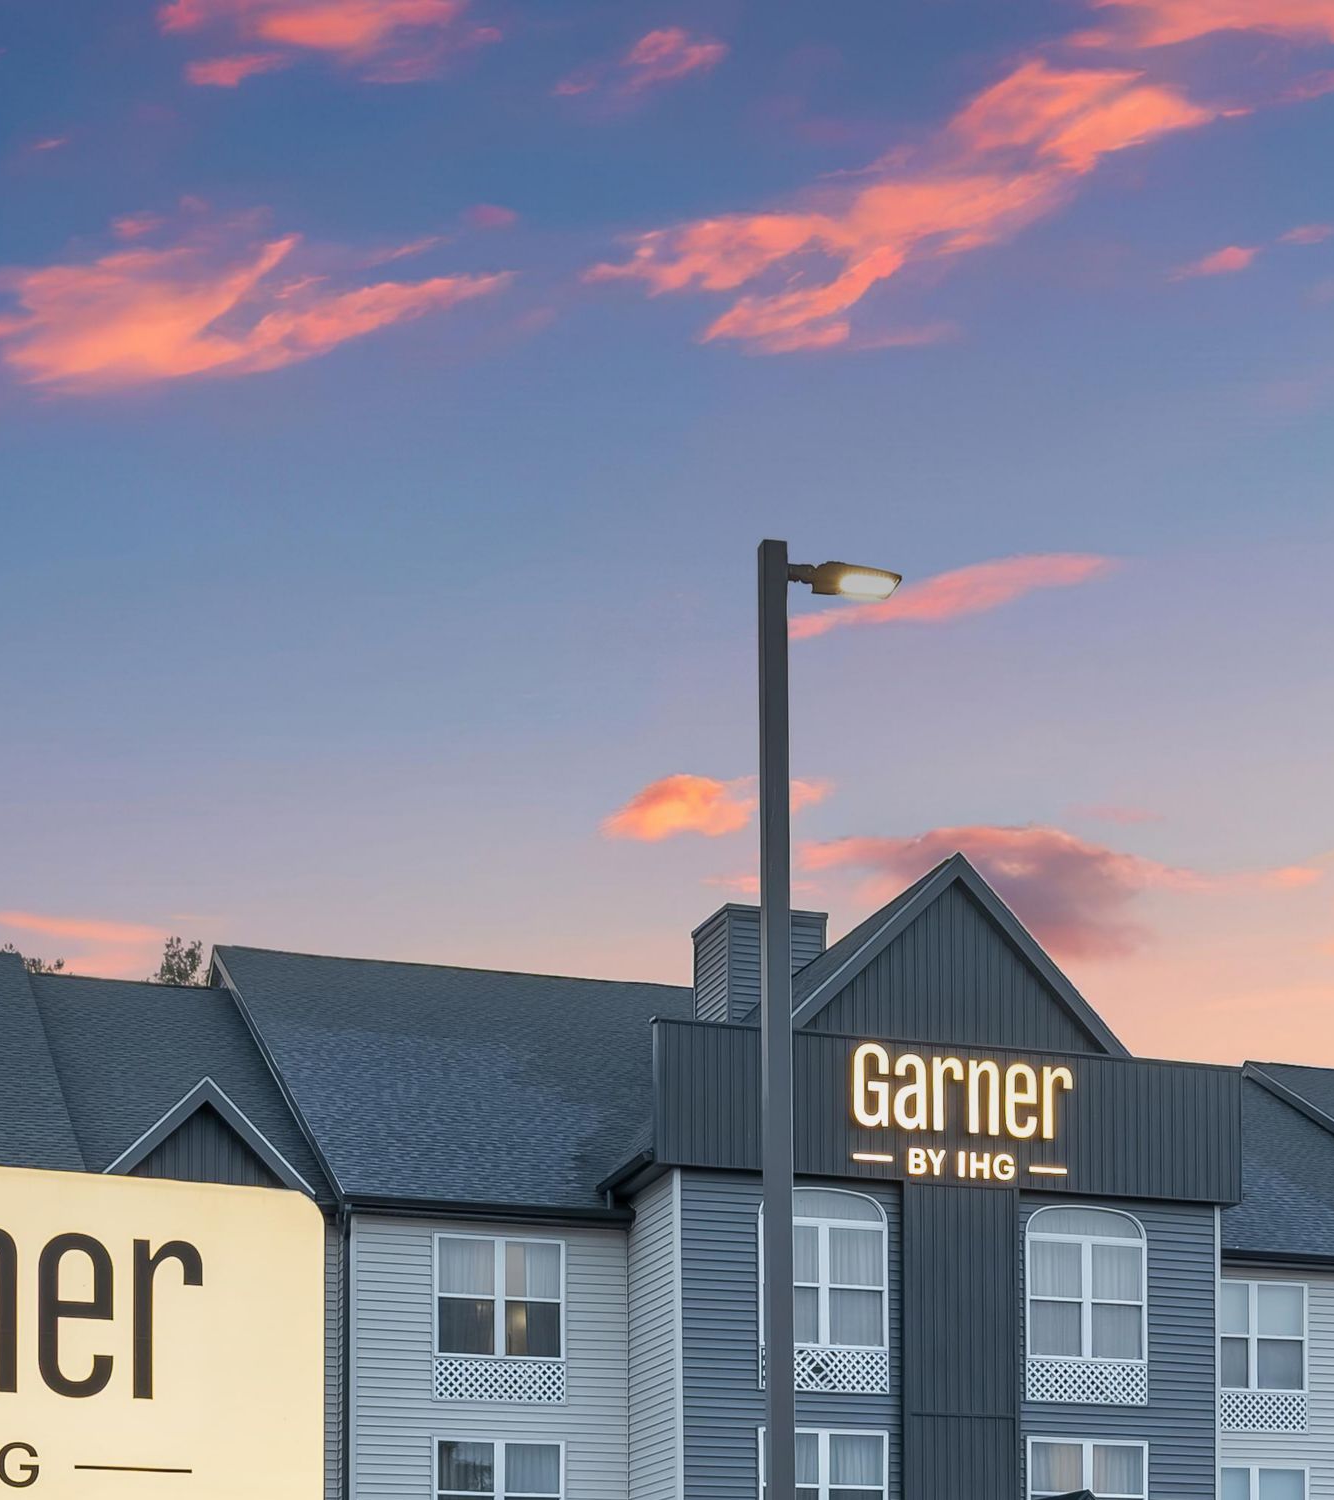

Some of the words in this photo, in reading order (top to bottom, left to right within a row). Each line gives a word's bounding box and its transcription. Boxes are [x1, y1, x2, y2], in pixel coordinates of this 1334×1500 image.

[851, 1041, 1074, 1141] Garner
[907, 1147, 947, 1176] BY
[957, 1150, 1016, 1181] IHG
